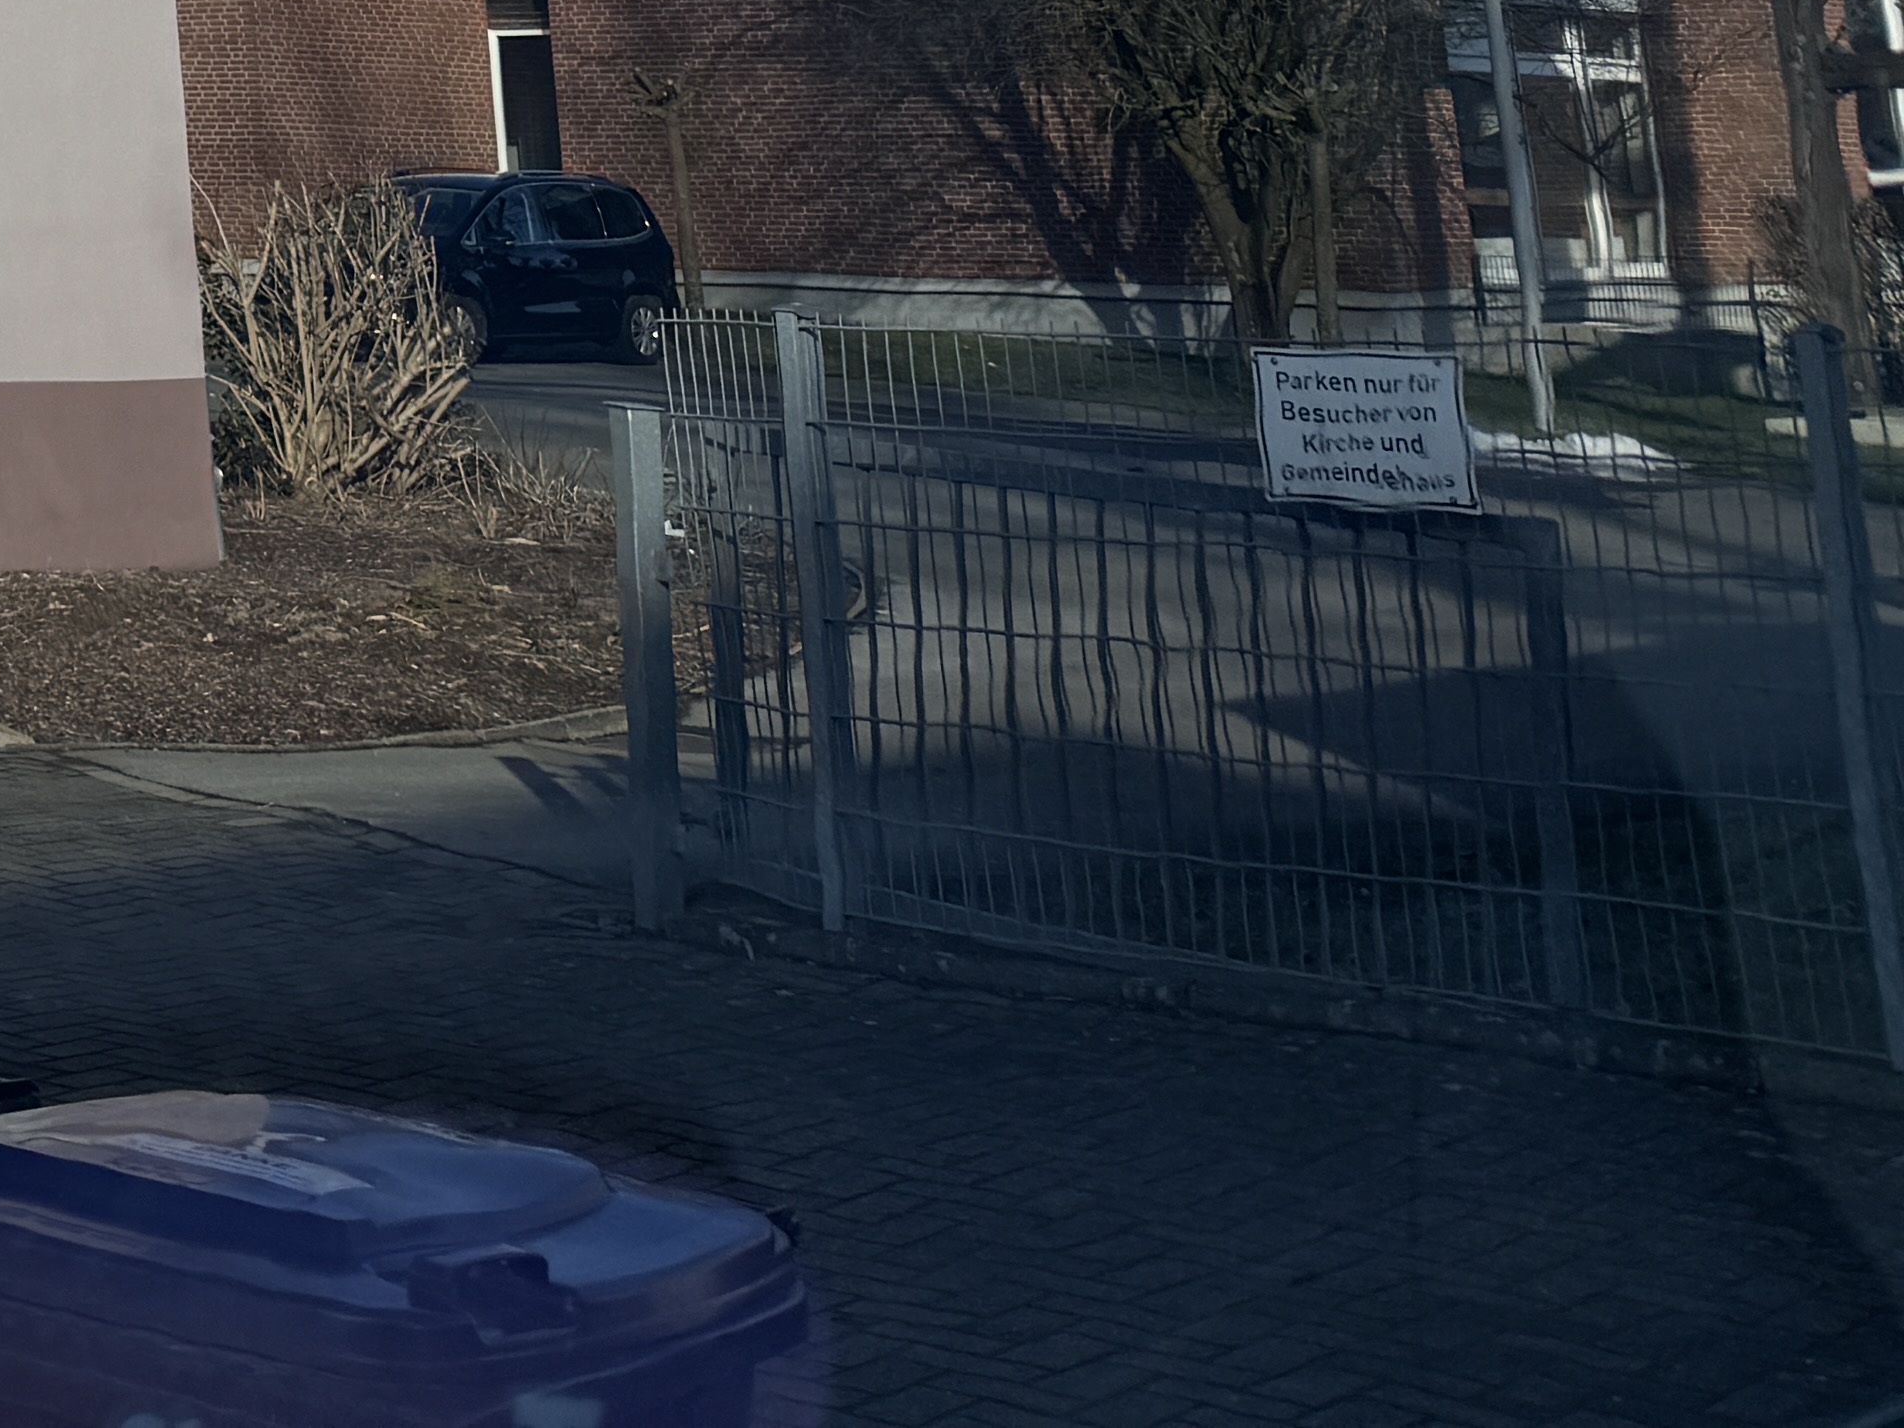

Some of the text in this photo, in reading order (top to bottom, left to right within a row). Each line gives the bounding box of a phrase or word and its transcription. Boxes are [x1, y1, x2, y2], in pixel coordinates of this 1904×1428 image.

[1275, 370, 1441, 394] Parken nur für
[1281, 400, 1437, 424] Besucher von
[1302, 433, 1426, 456] Kirche und
[1281, 461, 1456, 492] Gemeindehaus
